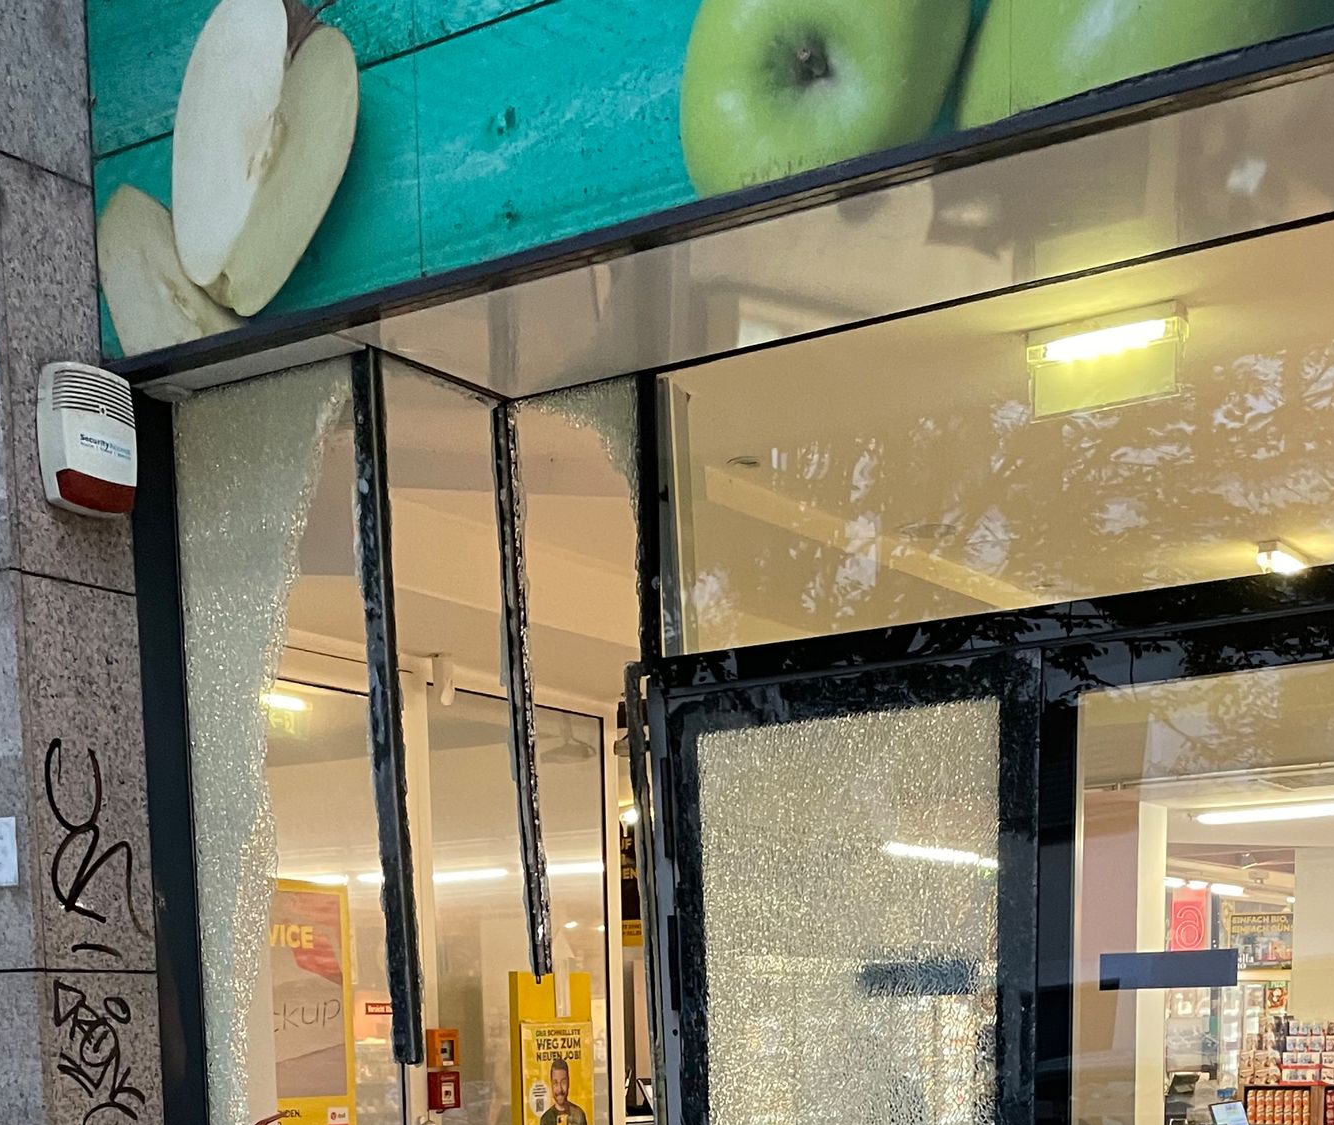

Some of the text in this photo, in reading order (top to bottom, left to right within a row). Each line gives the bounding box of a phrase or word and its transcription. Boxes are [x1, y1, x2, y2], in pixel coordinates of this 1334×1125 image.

[536, 1037, 581, 1051] WEG ZUM
[536, 1051, 562, 1062] NEUEN
